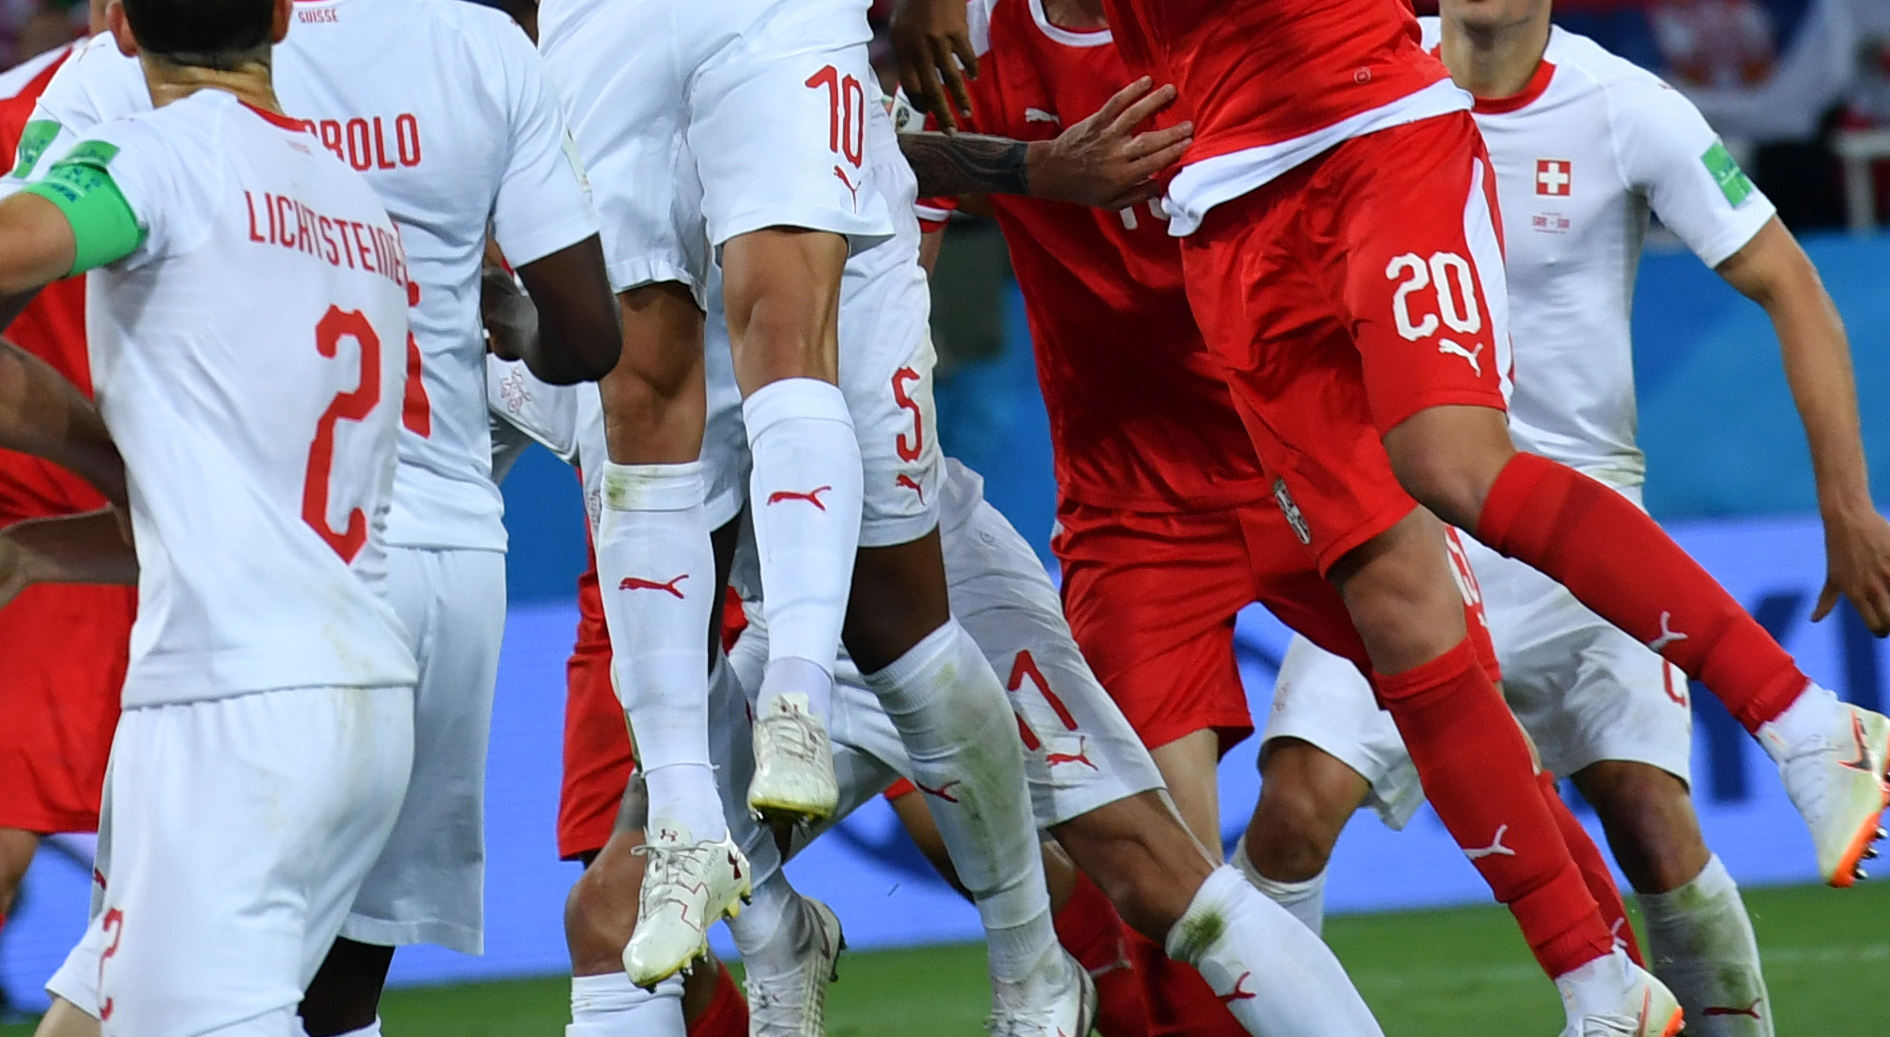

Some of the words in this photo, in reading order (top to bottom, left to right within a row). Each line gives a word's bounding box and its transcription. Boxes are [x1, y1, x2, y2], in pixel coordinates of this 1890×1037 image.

[297, 8, 339, 23] SUISSE
[805, 64, 864, 169] 10
[244, 189, 409, 290] LICHTSTEINE
[1385, 251, 1481, 341] 20
[300, 303, 381, 566] 2
[891, 366, 922, 463] 5
[98, 908, 123, 1021] 2
